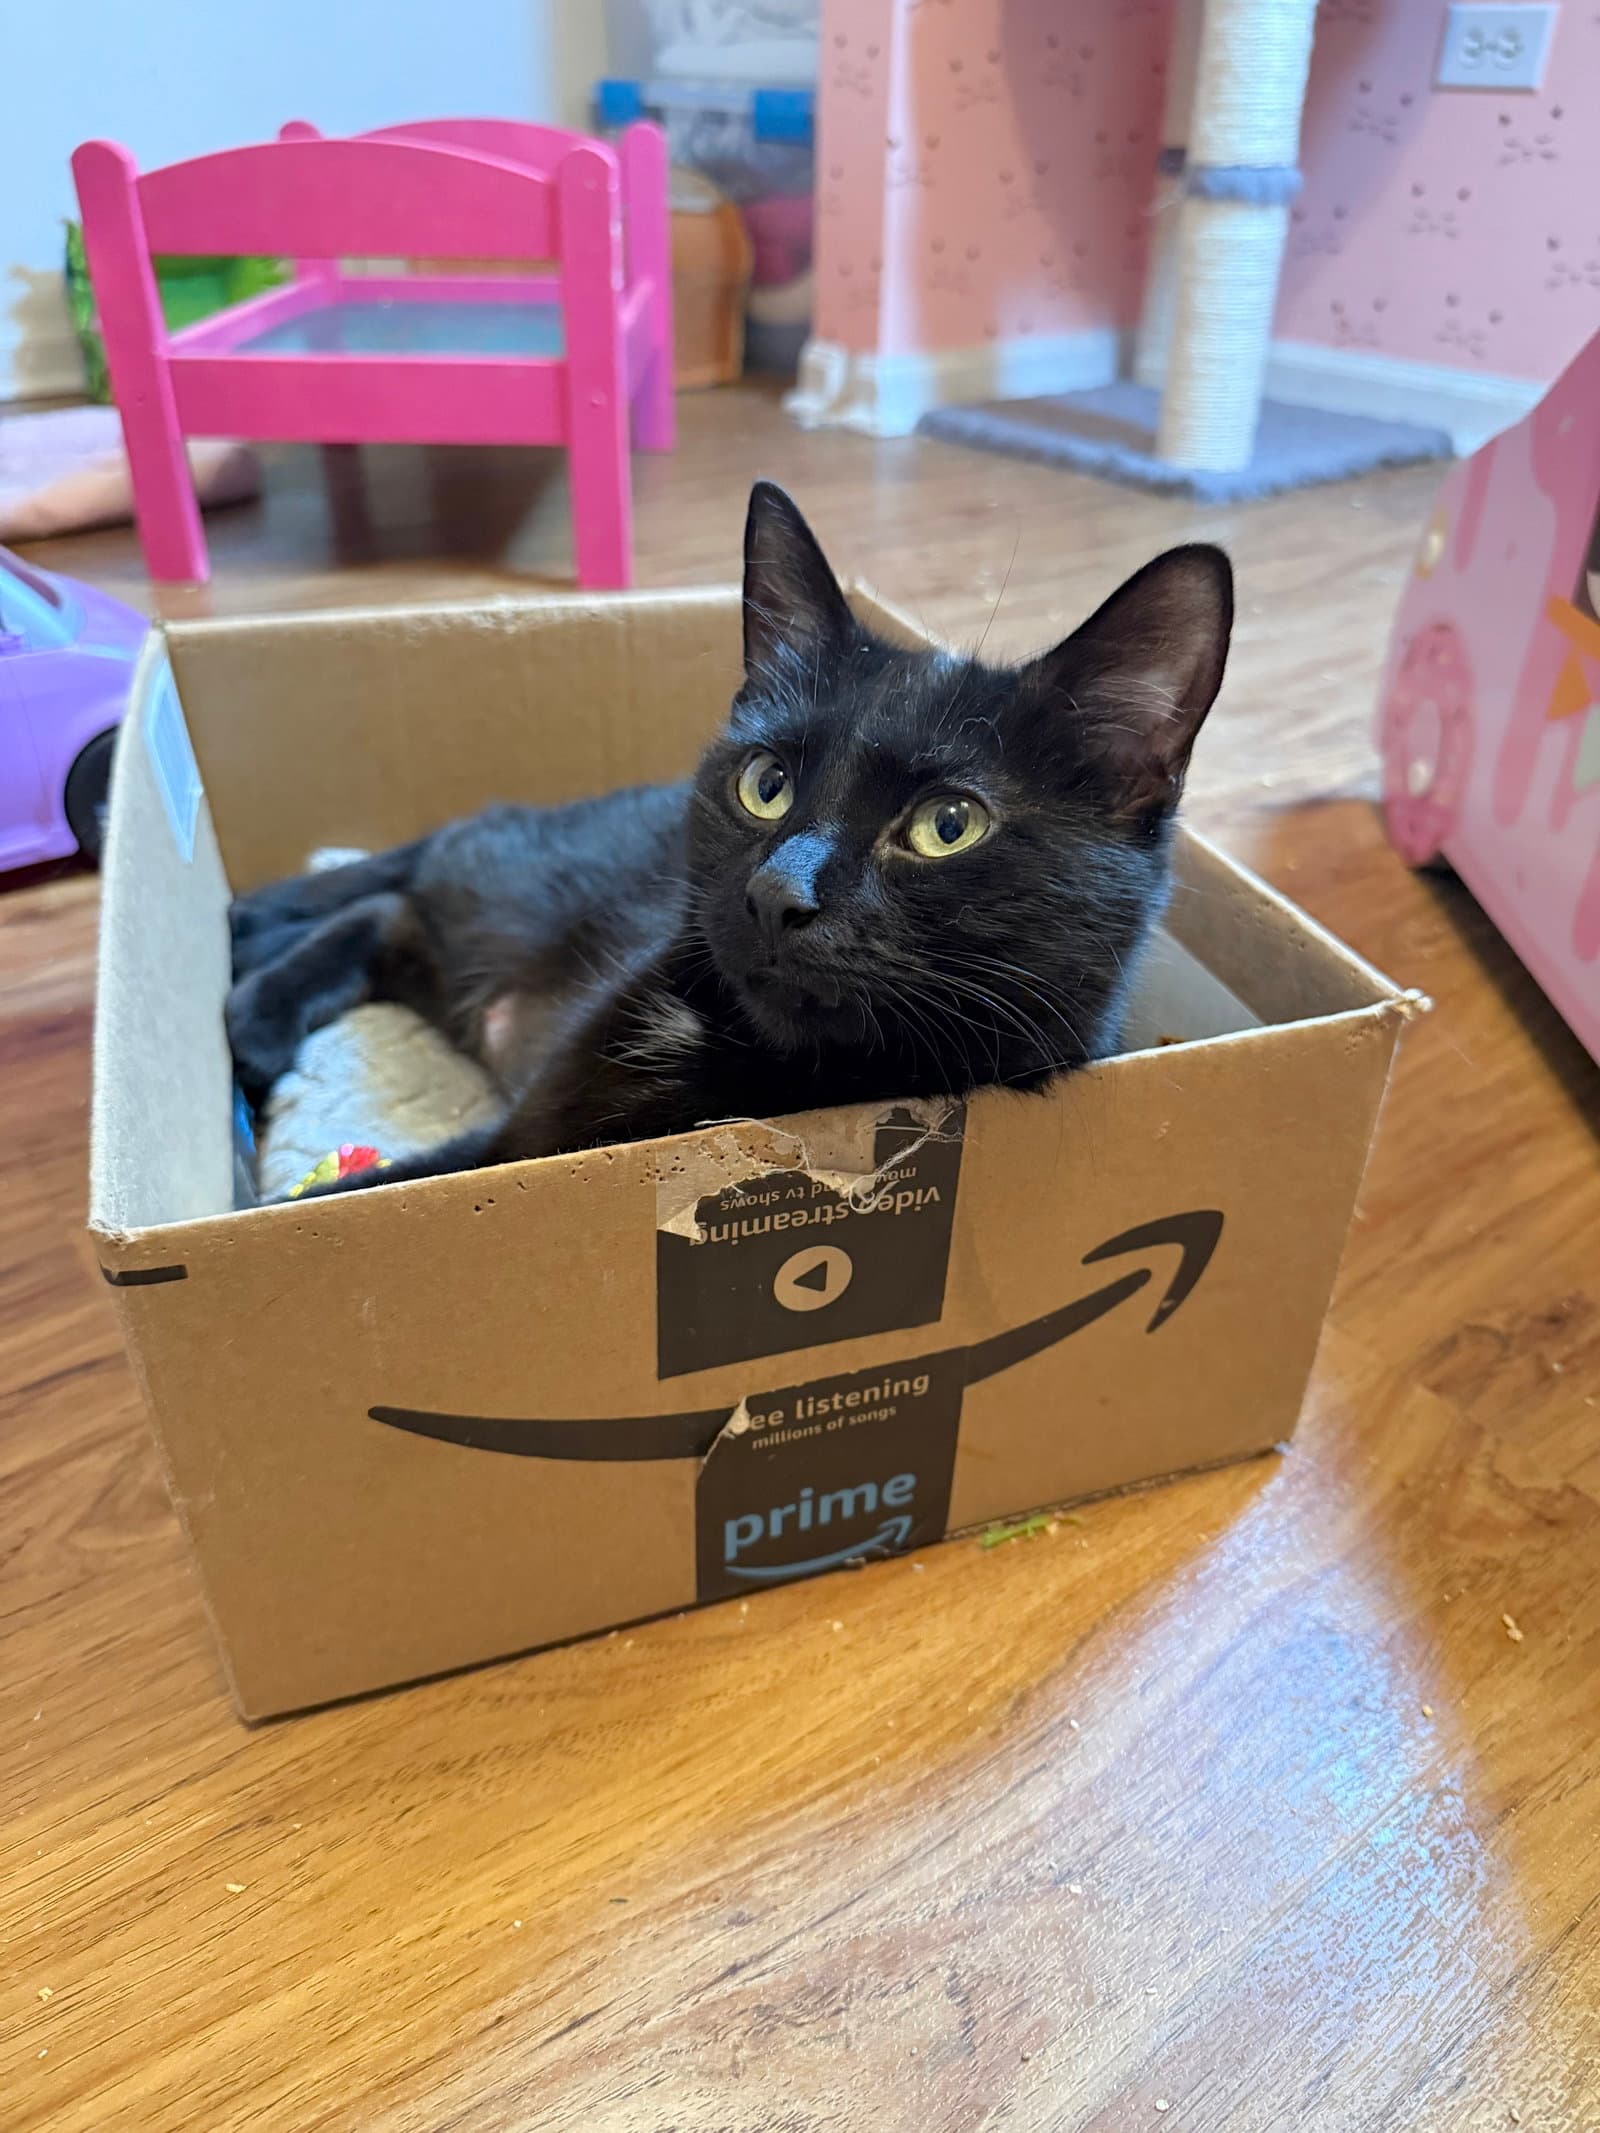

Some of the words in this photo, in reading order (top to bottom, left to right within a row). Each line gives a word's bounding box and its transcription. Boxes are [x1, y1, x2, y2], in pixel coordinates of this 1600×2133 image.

[876, 1166, 917, 1183] mov
[720, 1190, 780, 1211] shows
[785, 1186, 805, 1200] tv
[811, 1183, 829, 1198] nd
[750, 1408, 784, 1431] ee
[795, 1374, 930, 1419] listening
[752, 1424, 822, 1449] millions
[826, 1415, 845, 1431] of
[849, 1406, 897, 1426] songs
[724, 1473, 917, 1561] prime
